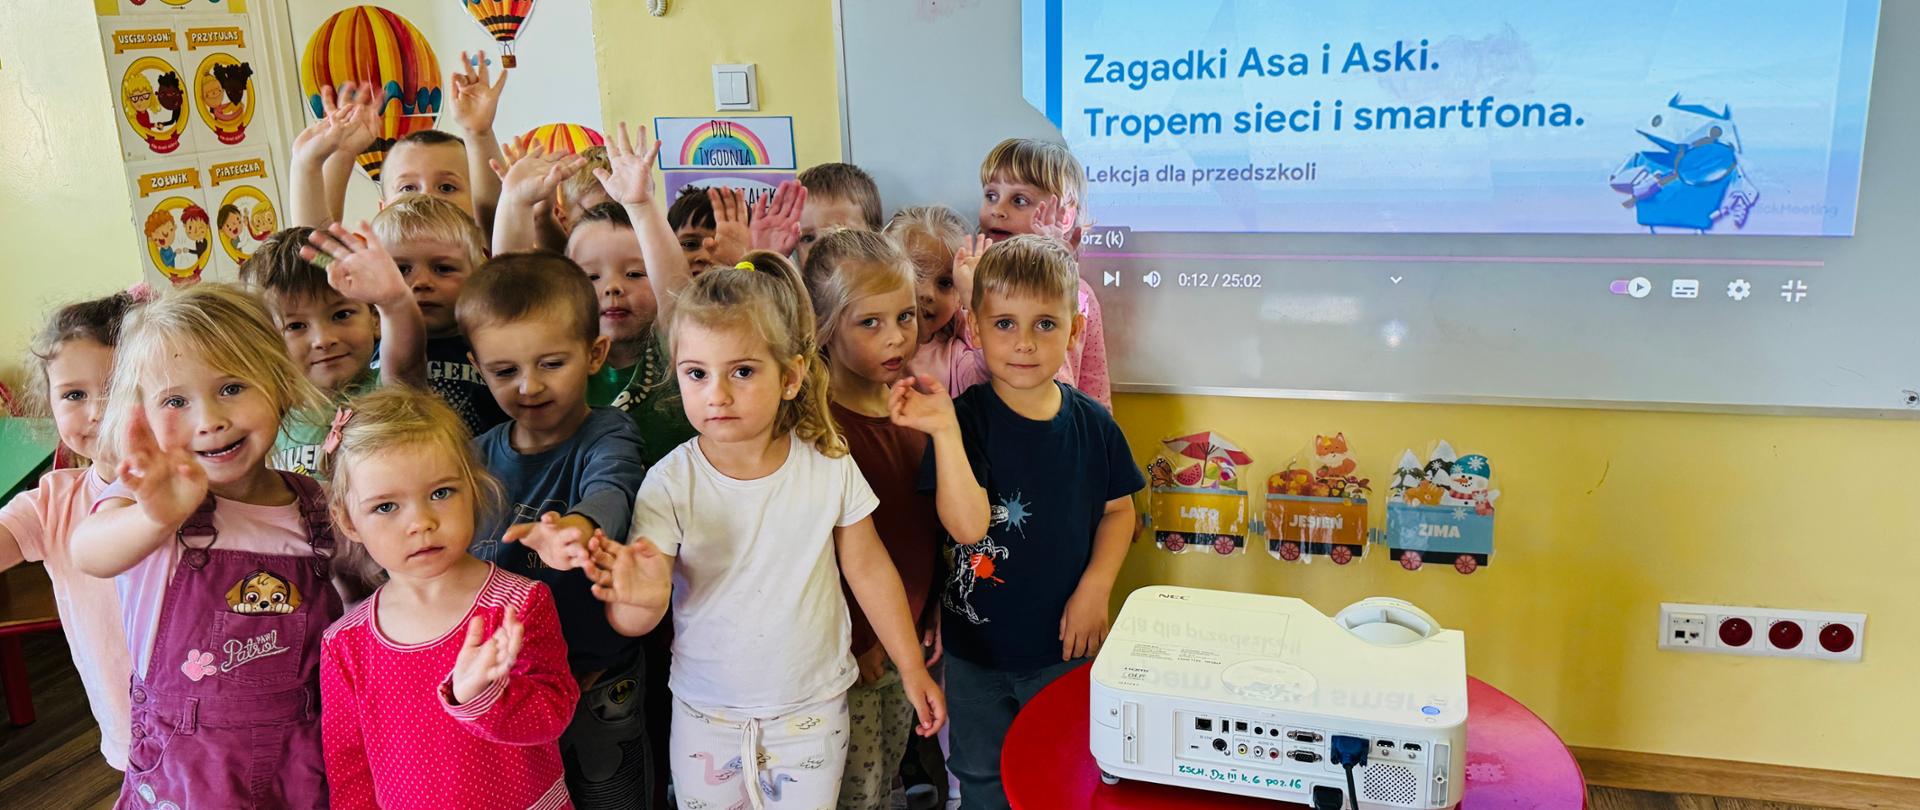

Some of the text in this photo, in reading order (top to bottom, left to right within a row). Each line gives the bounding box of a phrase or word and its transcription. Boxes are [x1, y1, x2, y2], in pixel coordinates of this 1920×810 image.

[1084, 39, 1440, 91] Zagadki Asa i Aski.
[710, 119, 733, 138] DNI
[1084, 96, 1585, 143] Tropem sieci i smartfona.
[697, 147, 752, 166] TYGODNIA
[1086, 162, 1317, 187] Lekcja dla przedszkoli
[1081, 230, 1124, 249] órz (k)
[1178, 272, 1262, 288] 0:12 / 25:02
[427, 360, 488, 385] GER
[1180, 505, 1220, 521] LATO
[1289, 513, 1343, 529] JESIEŃ
[1417, 523, 1461, 539] ZIMA
[222, 630, 286, 670] Patrol
